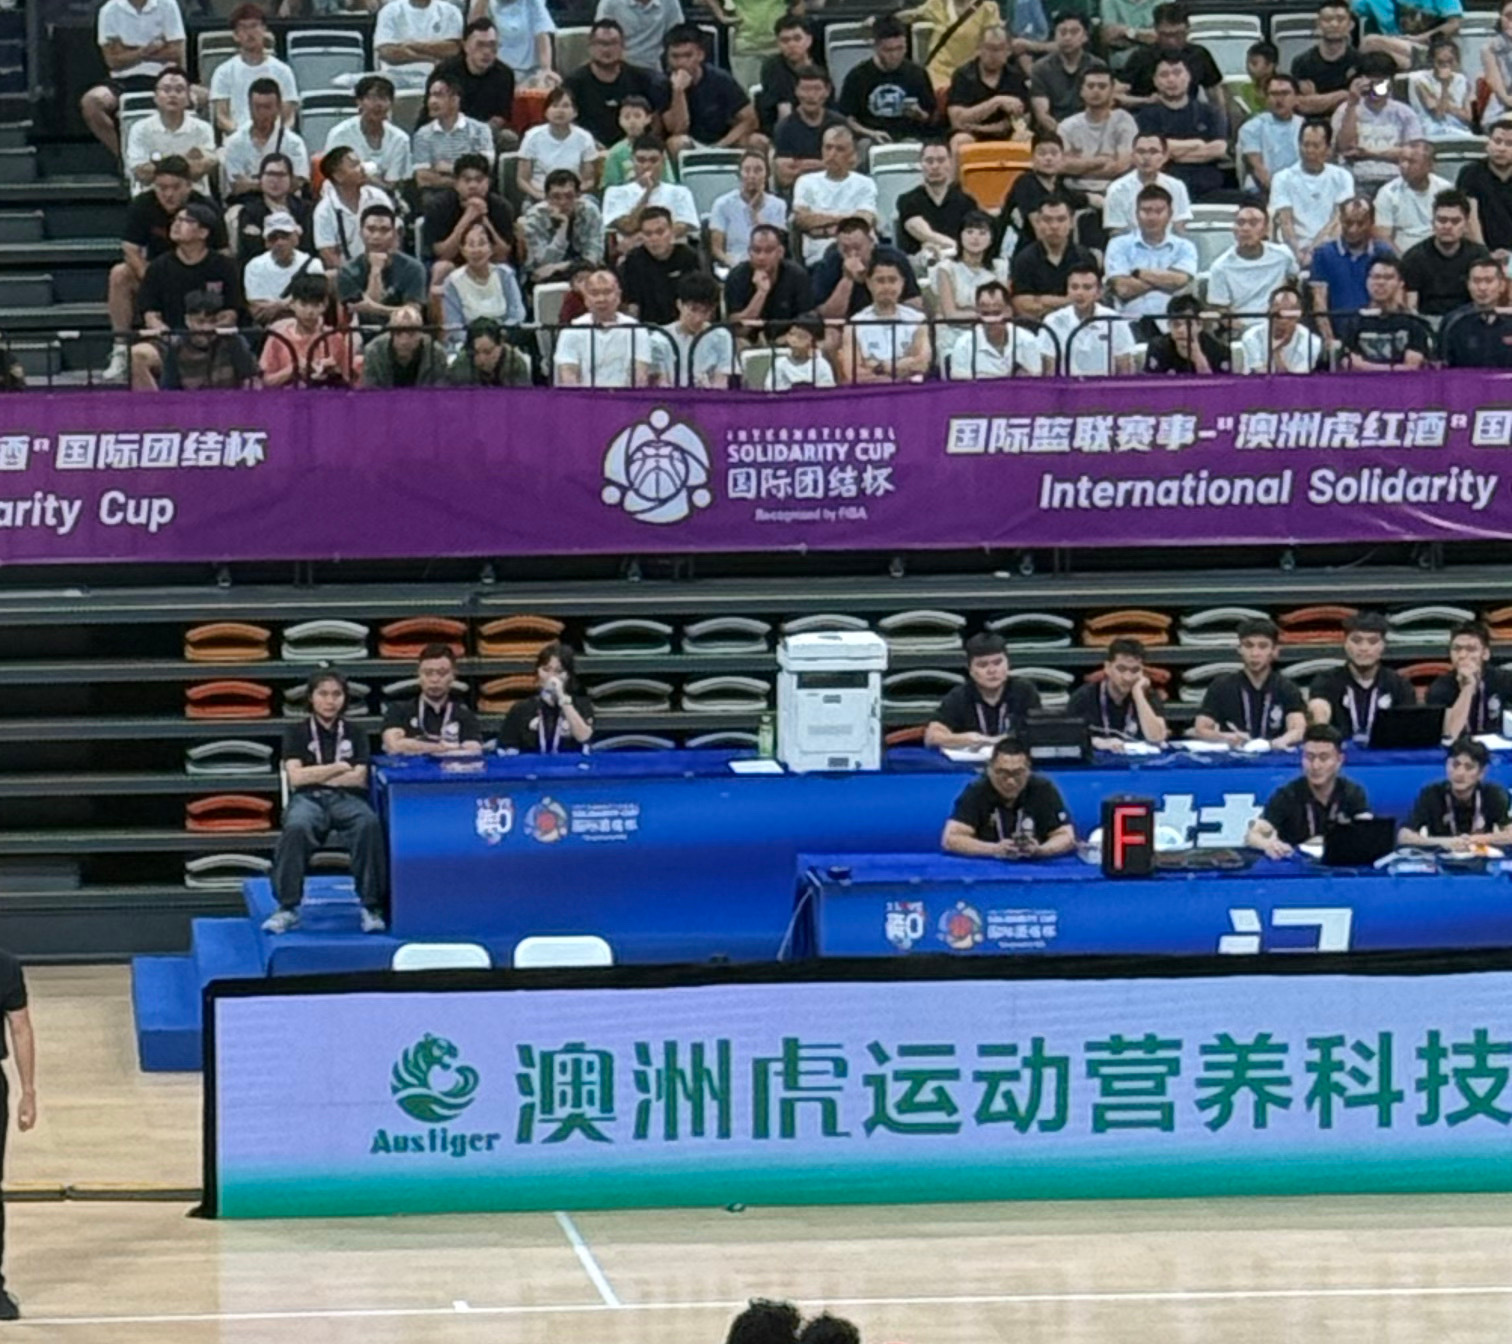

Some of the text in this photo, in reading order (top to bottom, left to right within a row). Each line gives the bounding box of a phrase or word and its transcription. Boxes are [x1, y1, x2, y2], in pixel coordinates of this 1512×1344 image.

[727, 442, 897, 463] SOLIDARITY CUP
[727, 465, 897, 499] 国际团结杯
[1039, 466, 1498, 510] International Solidarity
[99, 490, 175, 533] Cup
[1113, 806, 1147, 870] F
[369, 1127, 501, 1158] Austiger
